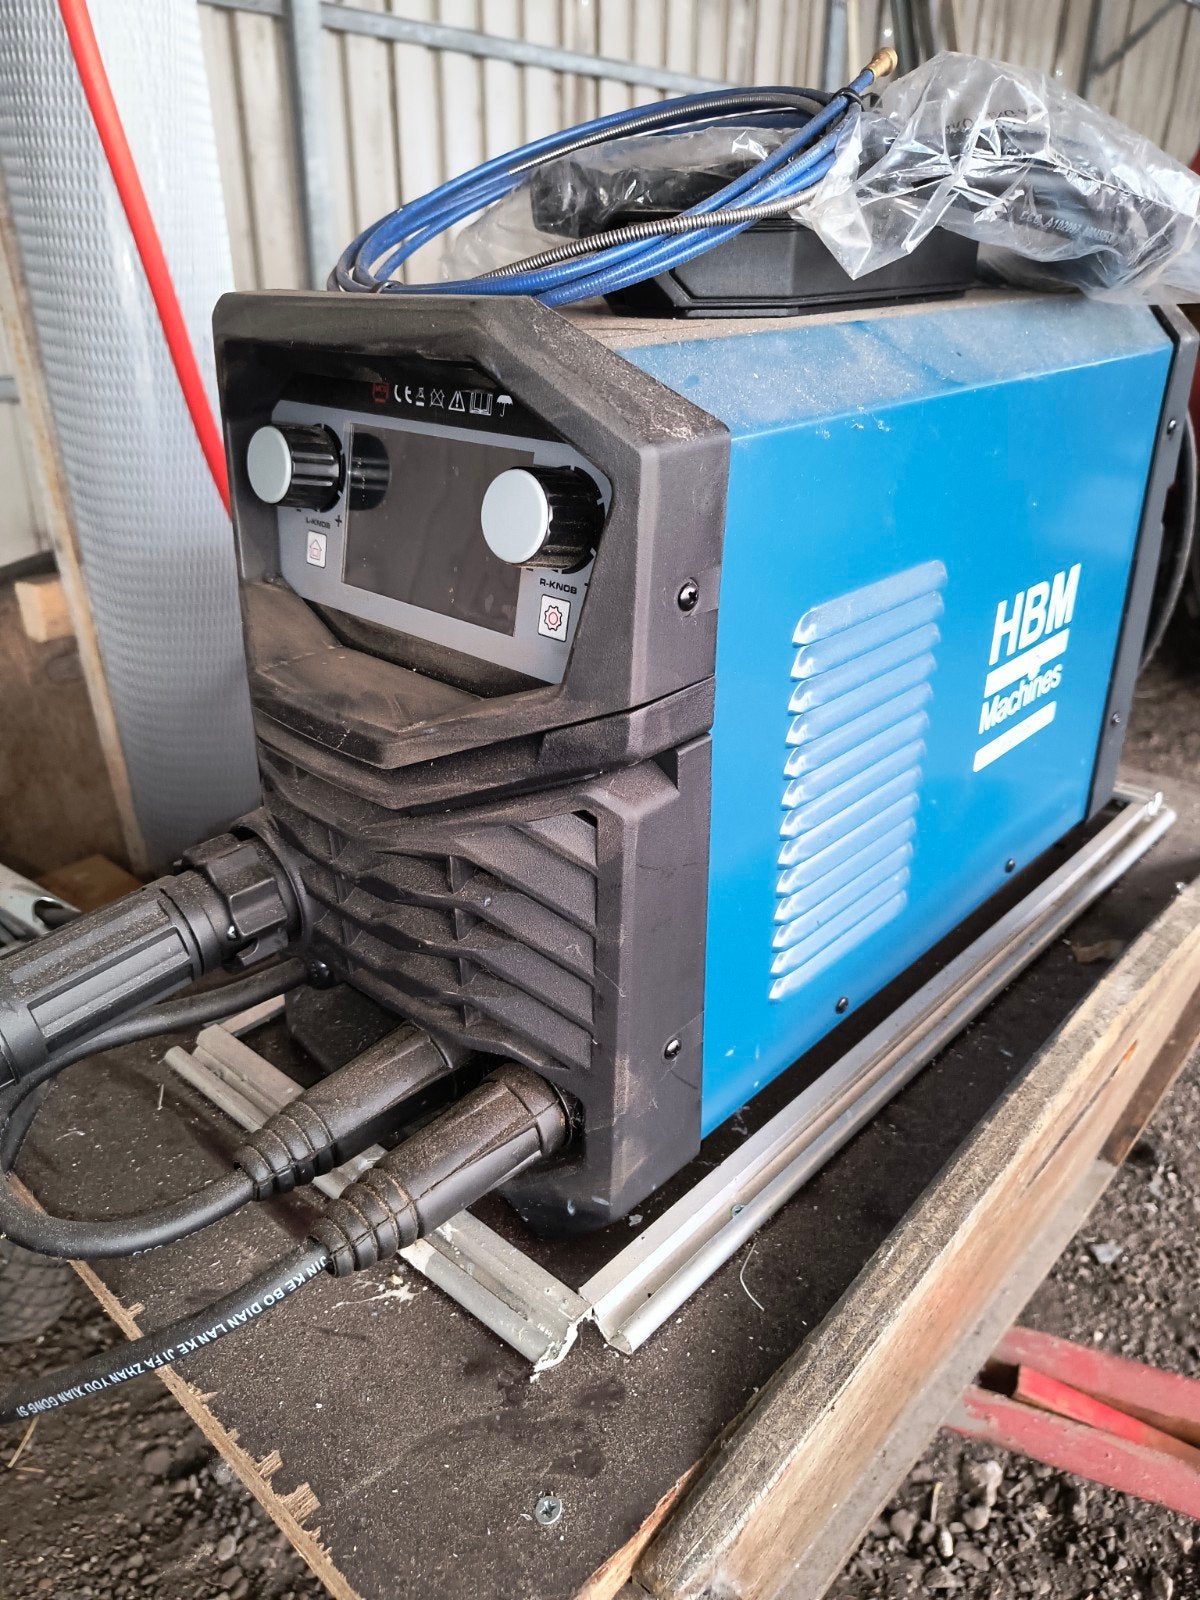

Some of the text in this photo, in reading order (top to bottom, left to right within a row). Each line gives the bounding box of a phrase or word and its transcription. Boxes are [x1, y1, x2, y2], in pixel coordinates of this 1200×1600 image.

[539, 577, 578, 595] R-KNOB
[988, 562, 1083, 666] HBM
[978, 663, 1064, 735] Machines
[305, 1255, 327, 1278] JIN
[284, 1272, 306, 1292] KE
[263, 1286, 286, 1306] BO
[226, 1301, 263, 1329] DIAN
[196, 1322, 228, 1345] LAN
[176, 1338, 200, 1355] KE
[144, 1354, 164, 1369] FA
[109, 1363, 146, 1384] ZHAN
[57, 1385, 87, 1403] XIAN
[85, 1377, 111, 1392] YOU
[27, 1396, 59, 1413] GONG
